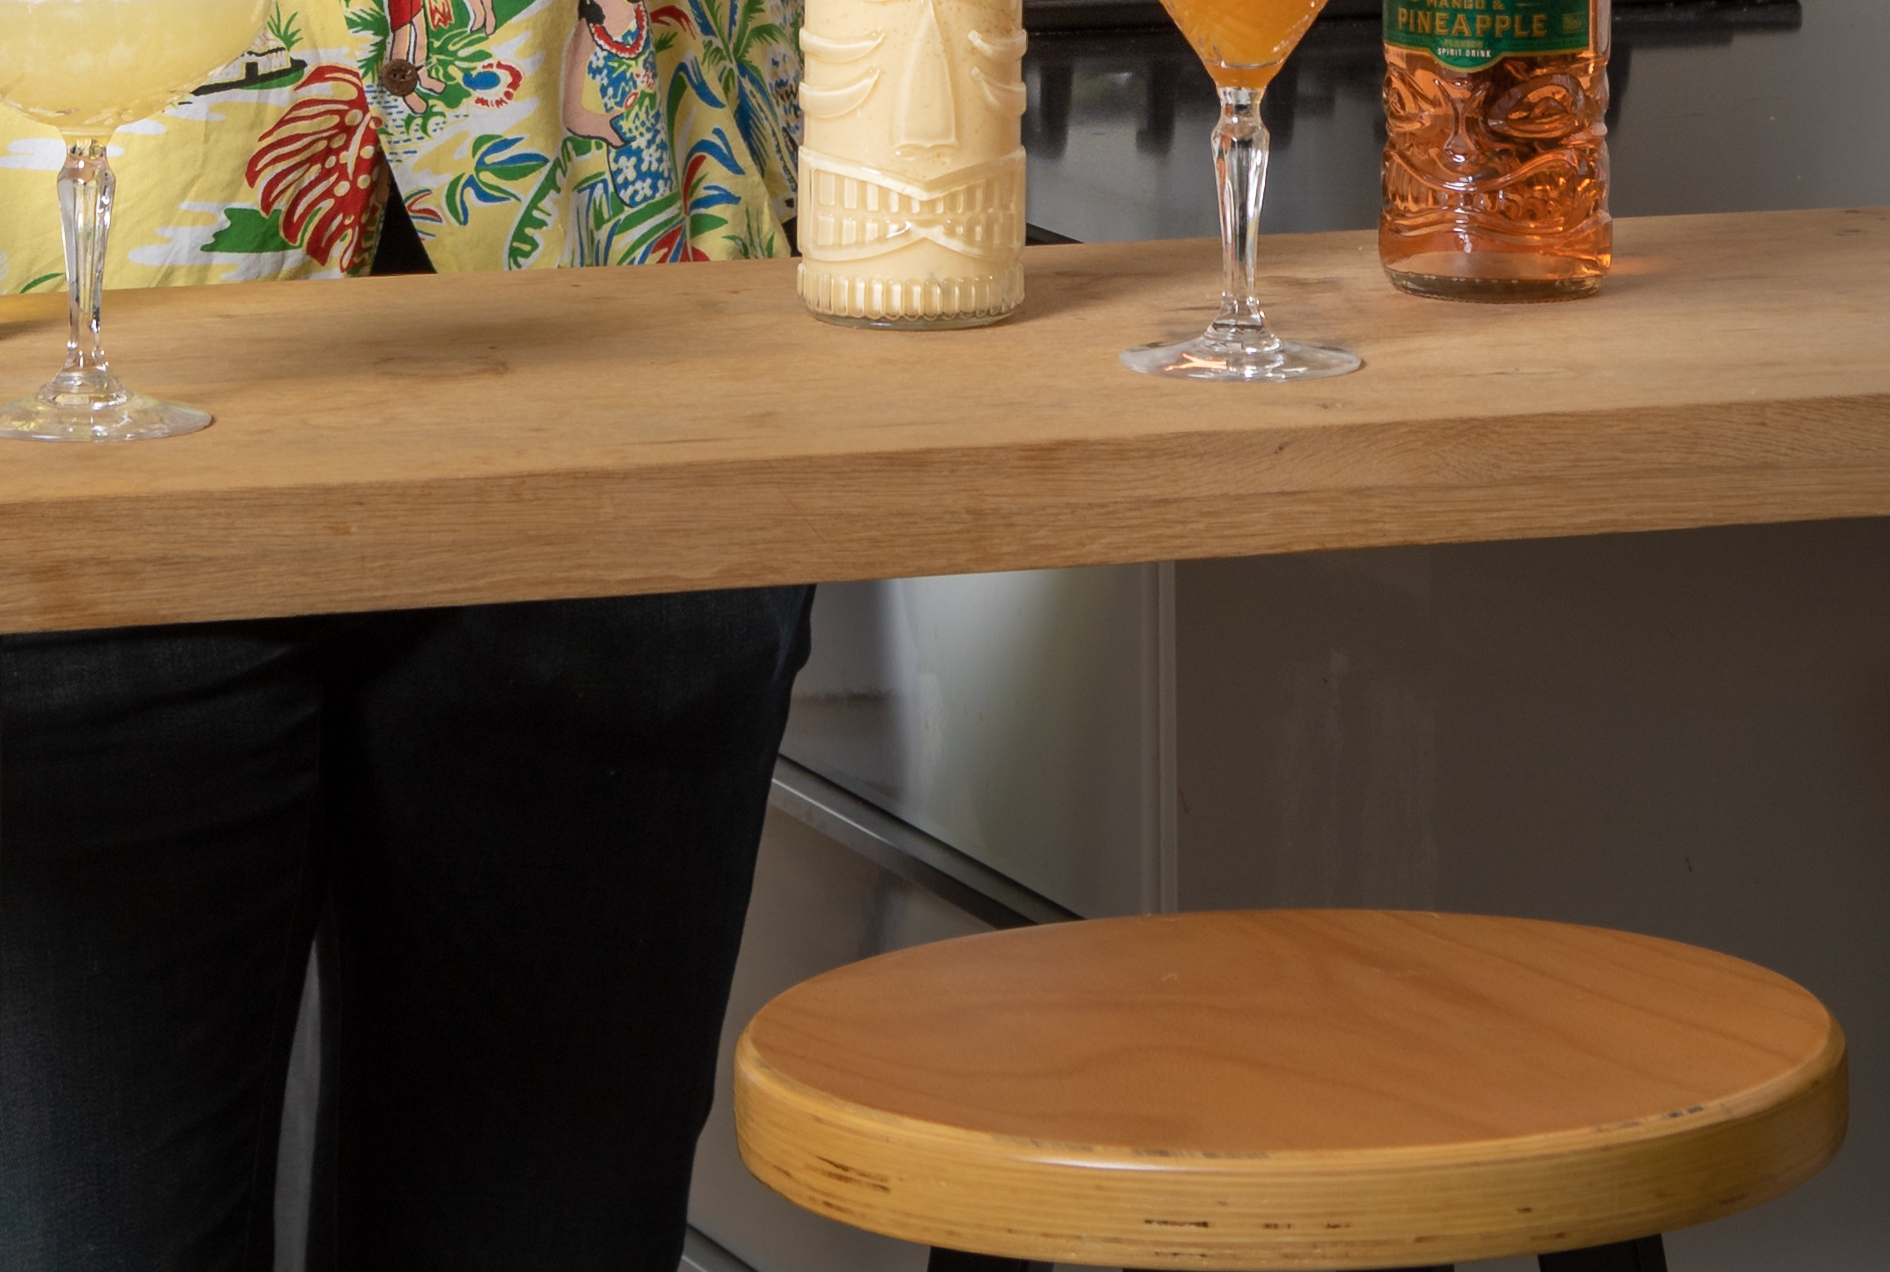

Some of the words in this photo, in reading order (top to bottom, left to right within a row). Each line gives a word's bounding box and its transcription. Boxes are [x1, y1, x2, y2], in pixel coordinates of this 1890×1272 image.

[1492, 0, 1506, 10] &
[1397, 7, 1548, 38] PINEAPPLE
[1437, 47, 1462, 57] SPIRIT
[1465, 49, 1492, 58] DRINK
